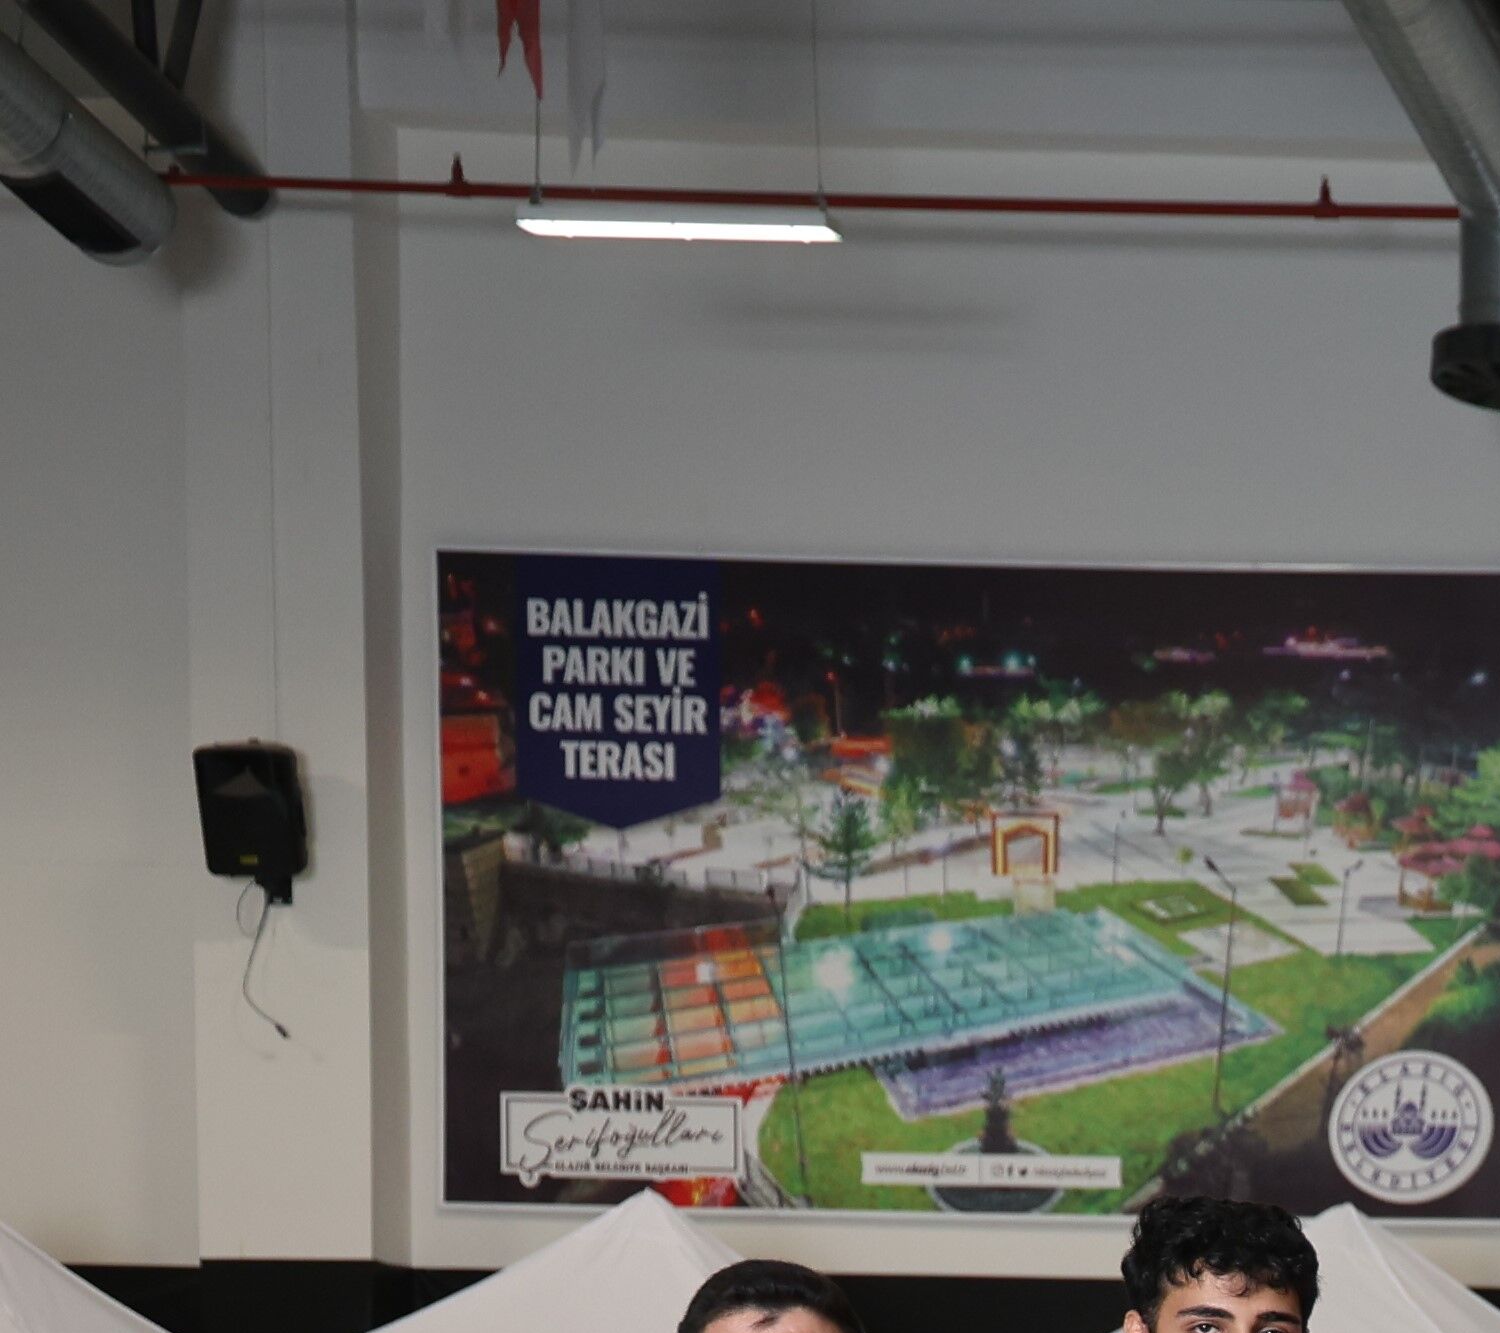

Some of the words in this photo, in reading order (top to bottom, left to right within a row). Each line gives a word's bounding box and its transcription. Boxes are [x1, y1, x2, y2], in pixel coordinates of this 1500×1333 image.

[526, 591, 709, 640] BALAKGAZİ
[542, 645, 645, 685] PARKI
[656, 648, 697, 687] VE
[528, 691, 603, 732] CAM
[614, 686, 708, 735] SEYİR
[560, 740, 677, 781] TERASI
